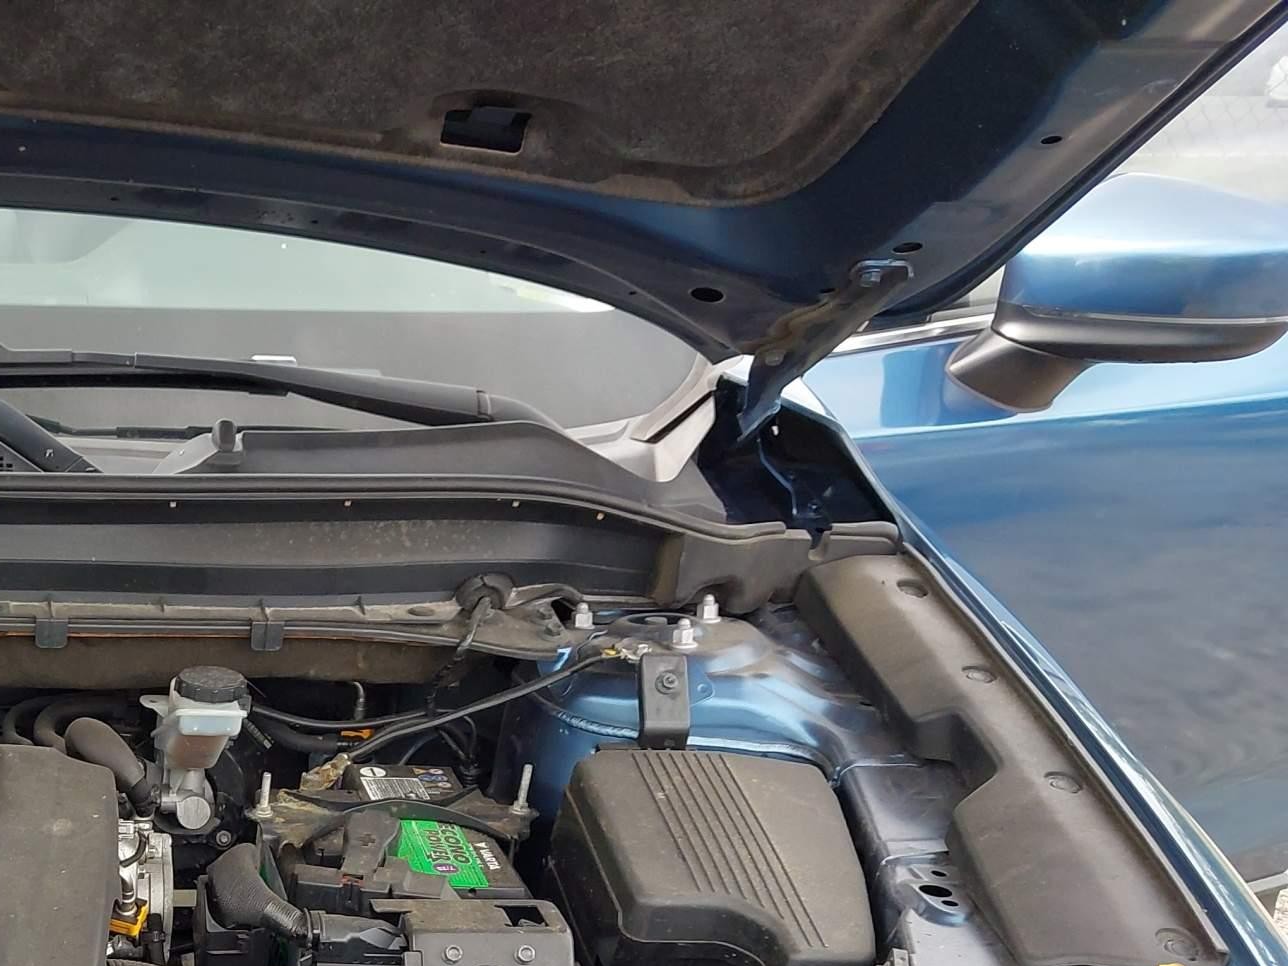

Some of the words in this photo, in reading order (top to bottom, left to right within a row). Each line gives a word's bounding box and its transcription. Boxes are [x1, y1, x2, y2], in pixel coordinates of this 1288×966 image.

[424, 829, 452, 863] POWER
[438, 822, 472, 864] ECONO
[479, 845, 501, 871] VARTA
